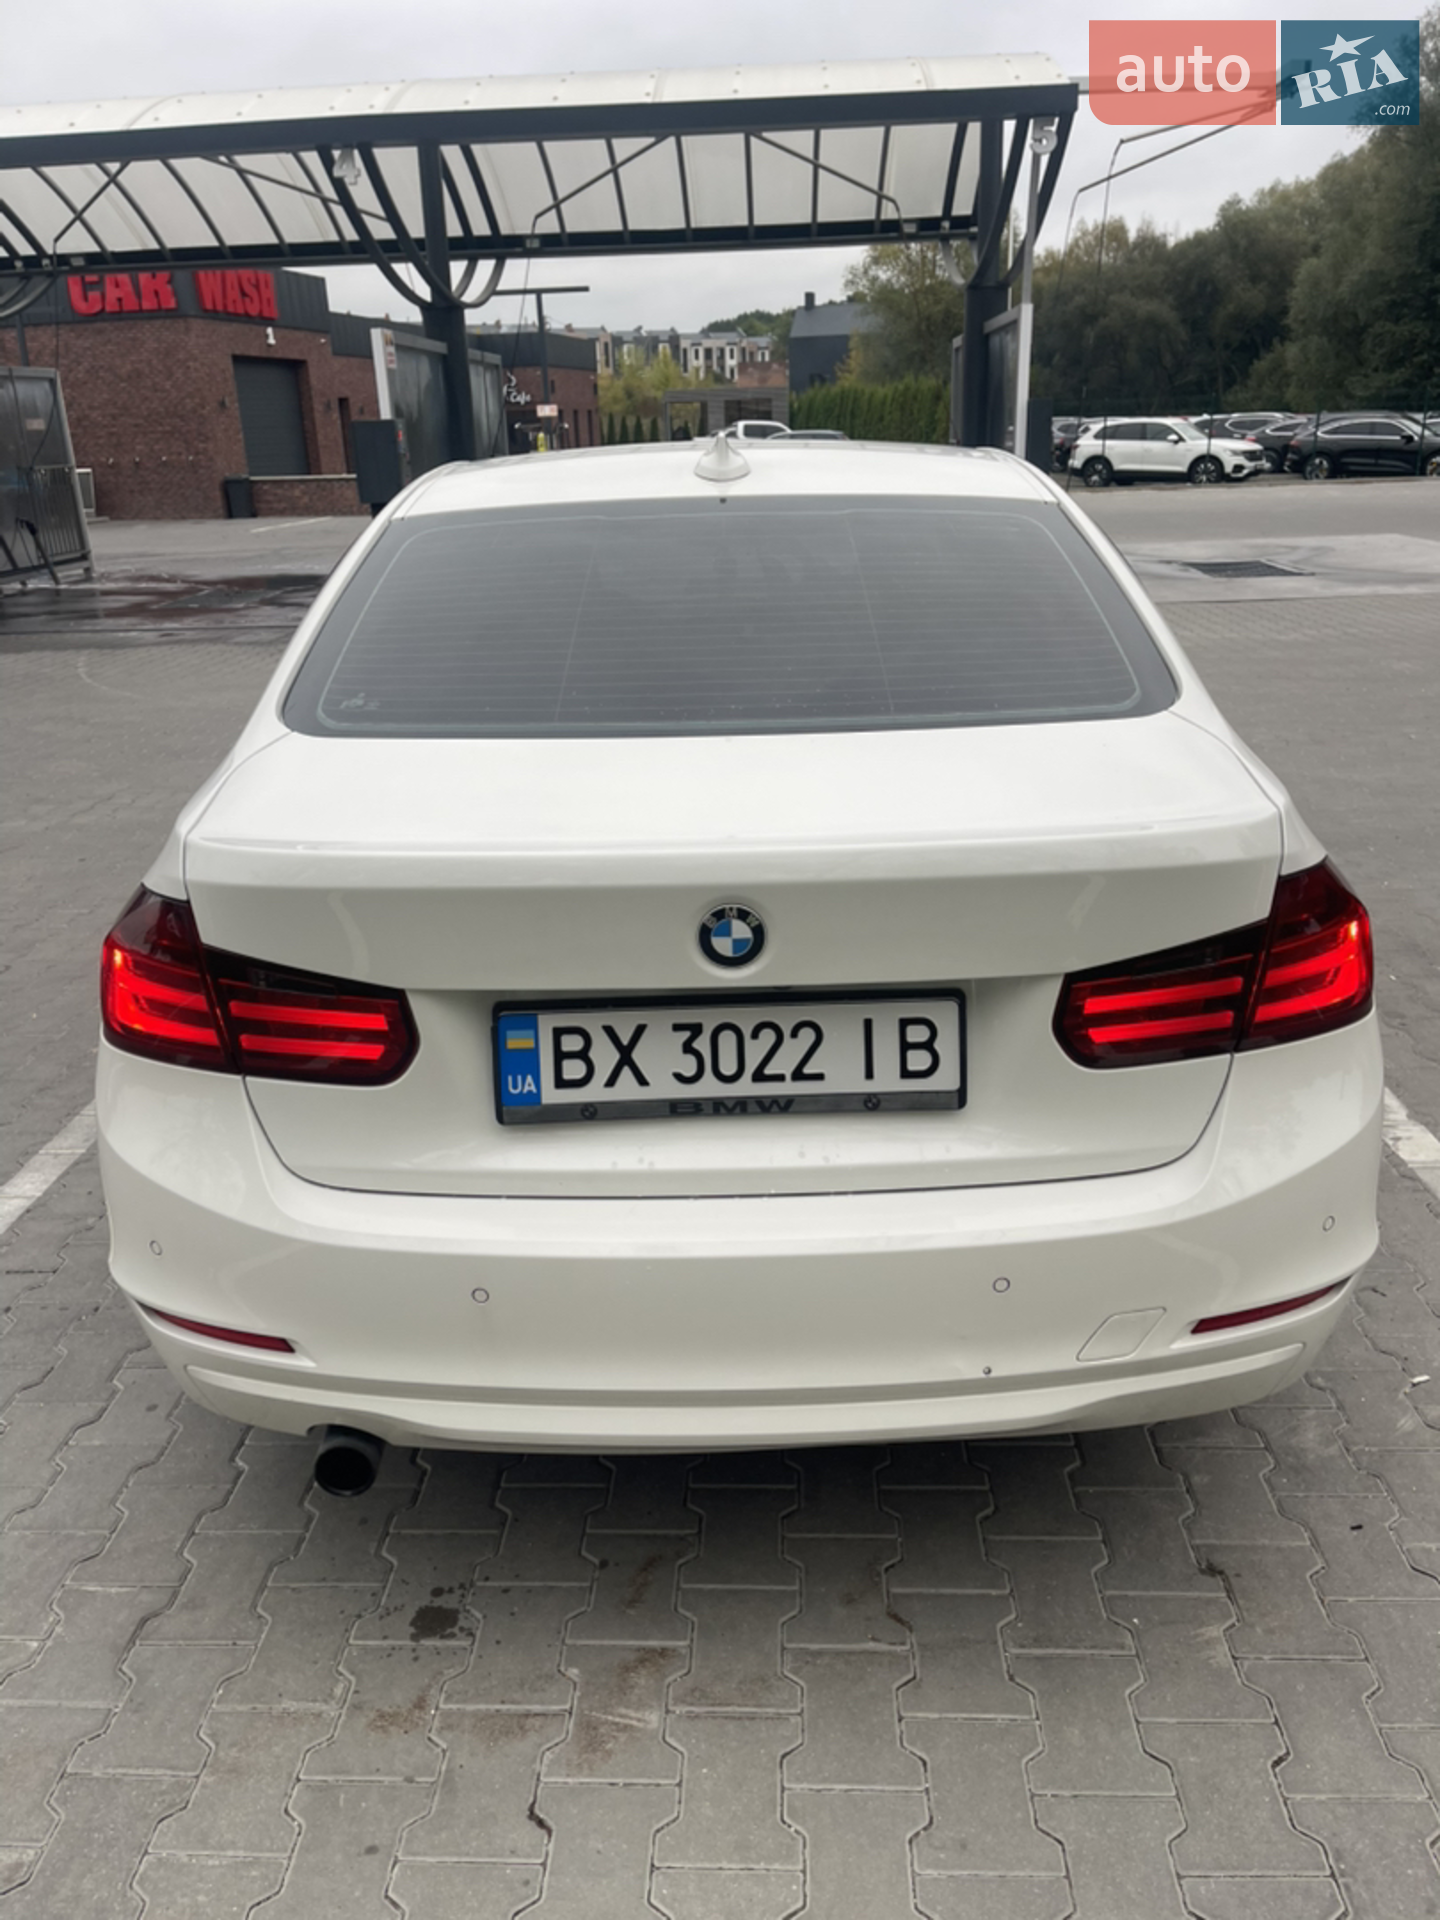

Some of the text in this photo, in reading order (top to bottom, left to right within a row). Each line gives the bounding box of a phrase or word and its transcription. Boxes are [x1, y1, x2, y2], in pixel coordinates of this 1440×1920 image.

[194, 270, 279, 319] WASH
[552, 1016, 941, 1090] BX 3022 IB
[507, 1074, 537, 1095] UA
[668, 1098, 796, 1115] BMW
